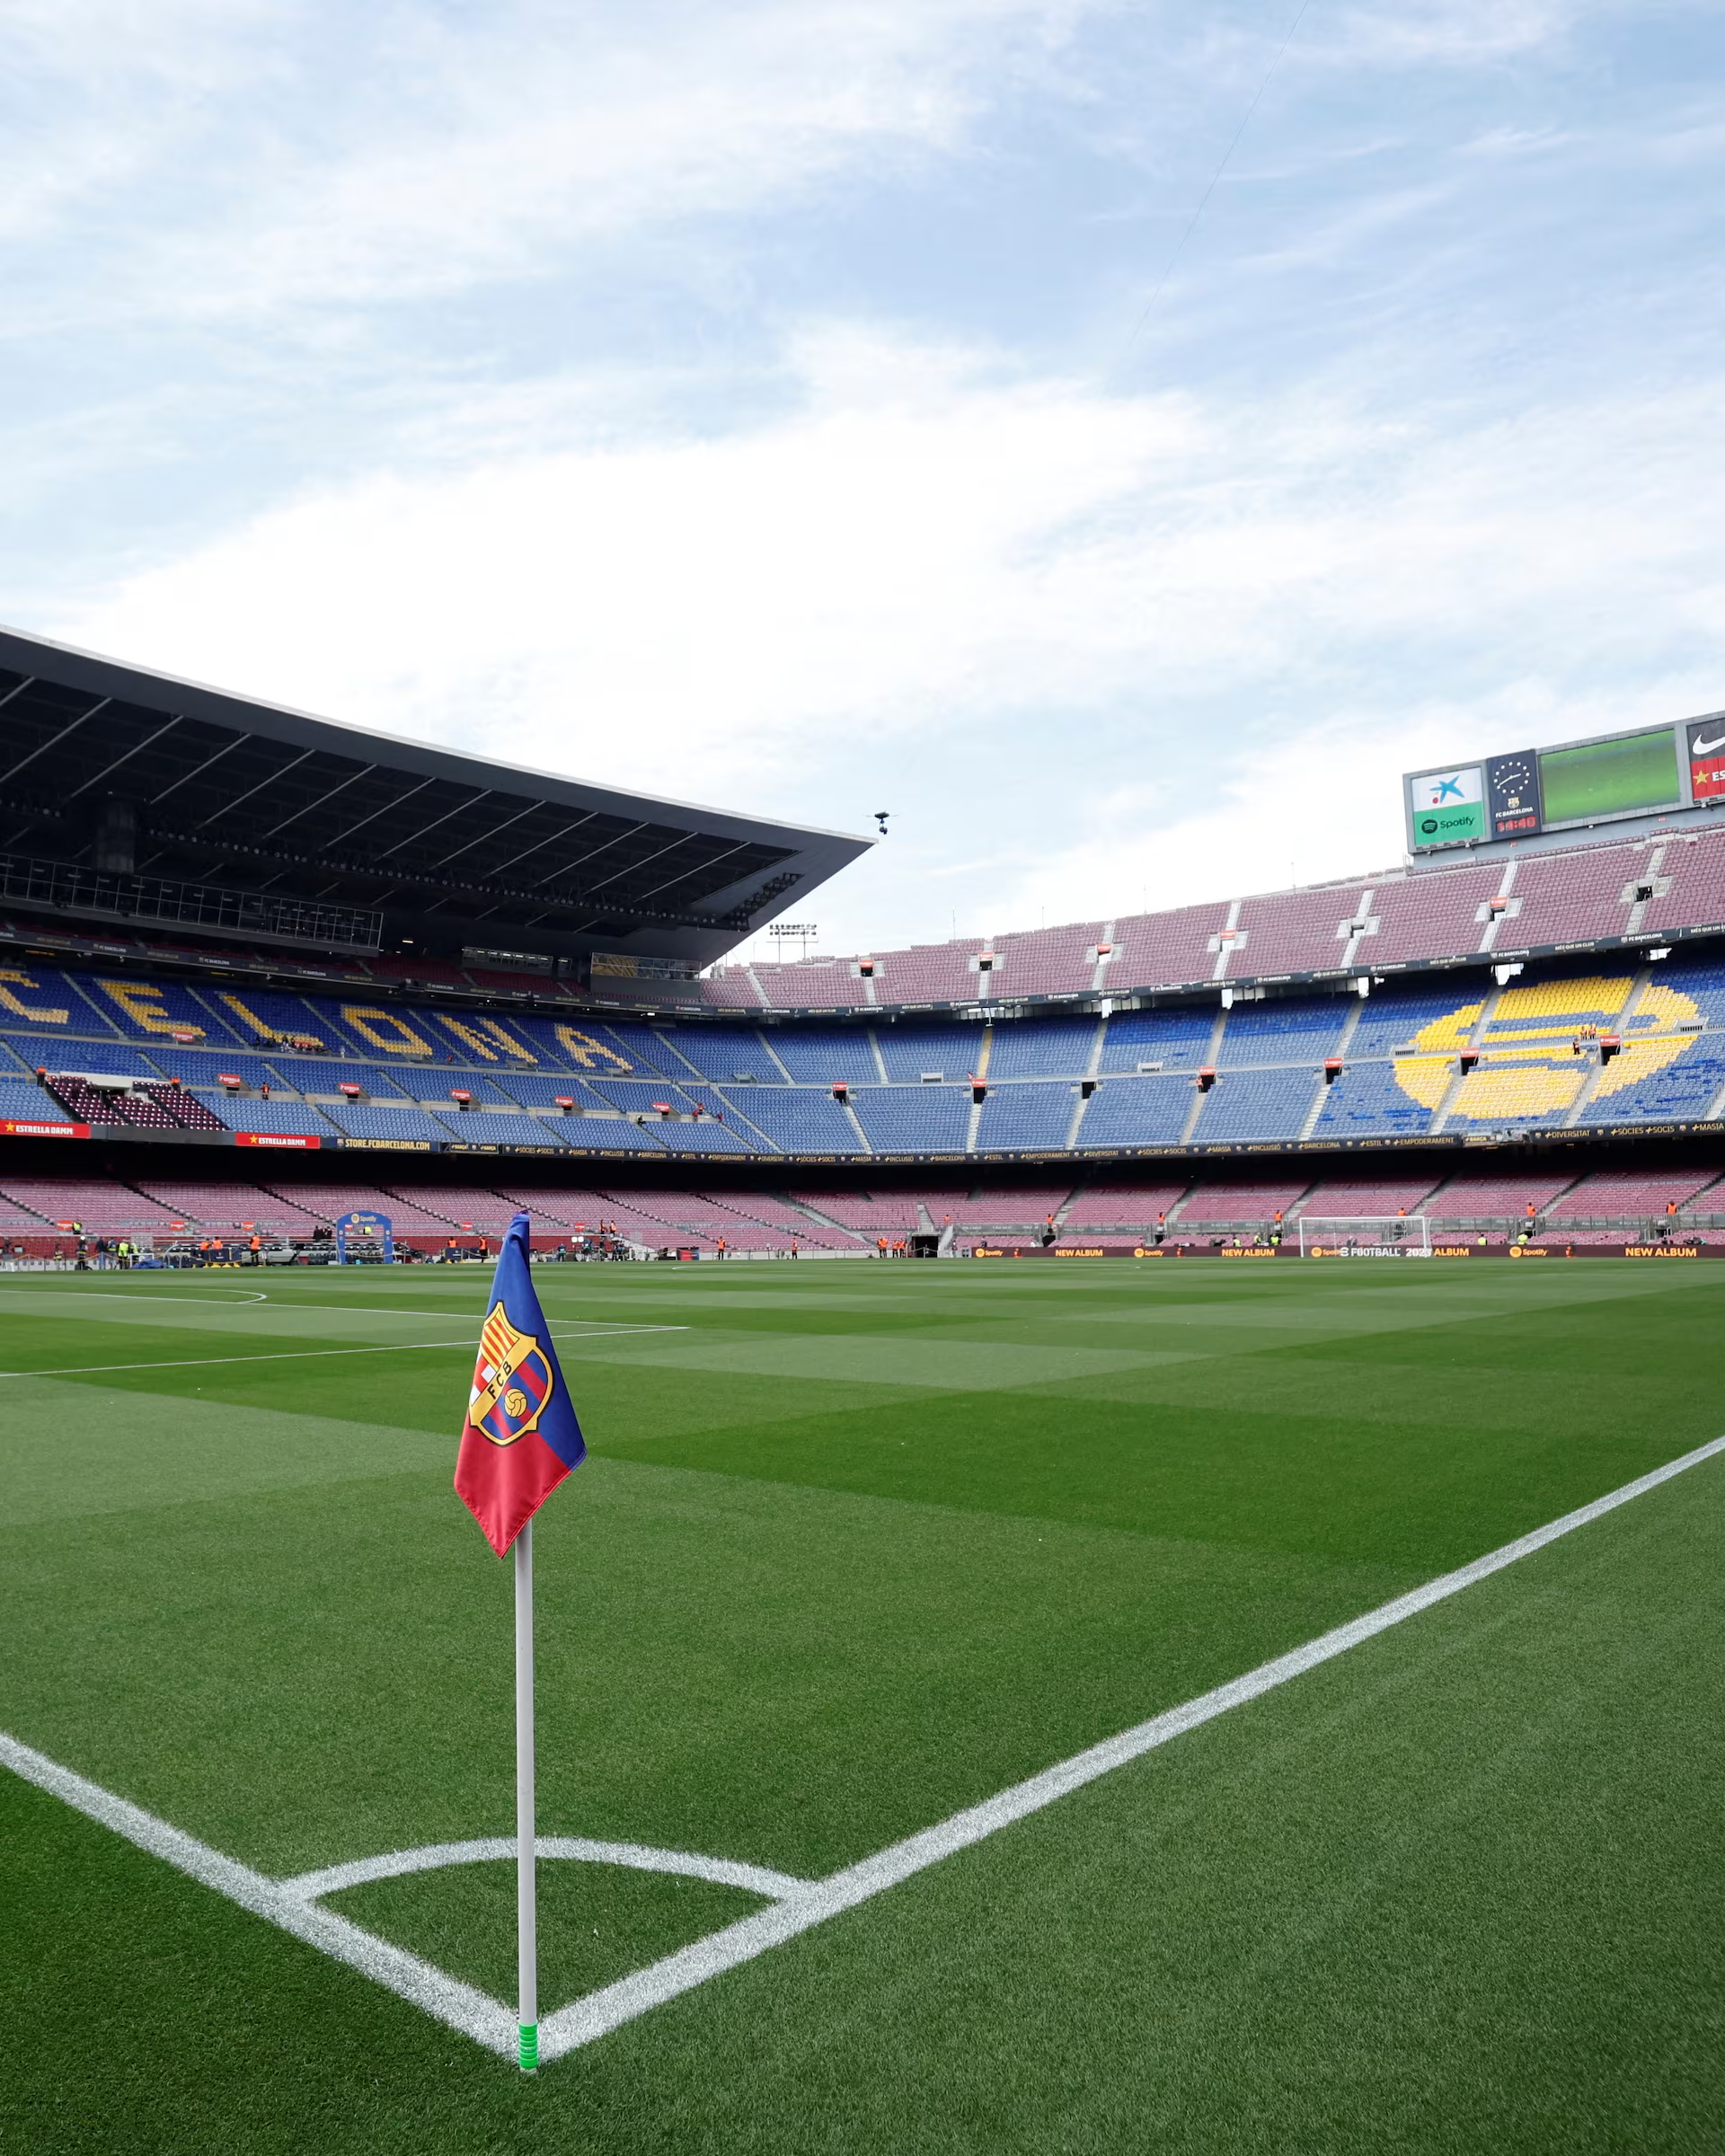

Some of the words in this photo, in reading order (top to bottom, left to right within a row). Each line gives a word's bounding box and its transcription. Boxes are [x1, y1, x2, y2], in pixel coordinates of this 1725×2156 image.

[1503, 807, 1533, 817] BARCELONA
[1440, 817, 1475, 829] Spotify
[16, 1125, 49, 1135] ESTRELLA
[50, 1126, 73, 1136] DAMM
[259, 1136, 286, 1145] ESTRELLA
[287, 1137, 306, 1146] DAMM
[345, 1139, 430, 1150] STORE.FCBARCELONA.COM
[1434, 1248, 1469, 1256] ALBUM
[1523, 1249, 1548, 1257] Spotify
[1625, 1248, 1654, 1256] NEW
[1655, 1248, 1697, 1257] ALBUM
[487, 1360, 512, 1400] FCB
